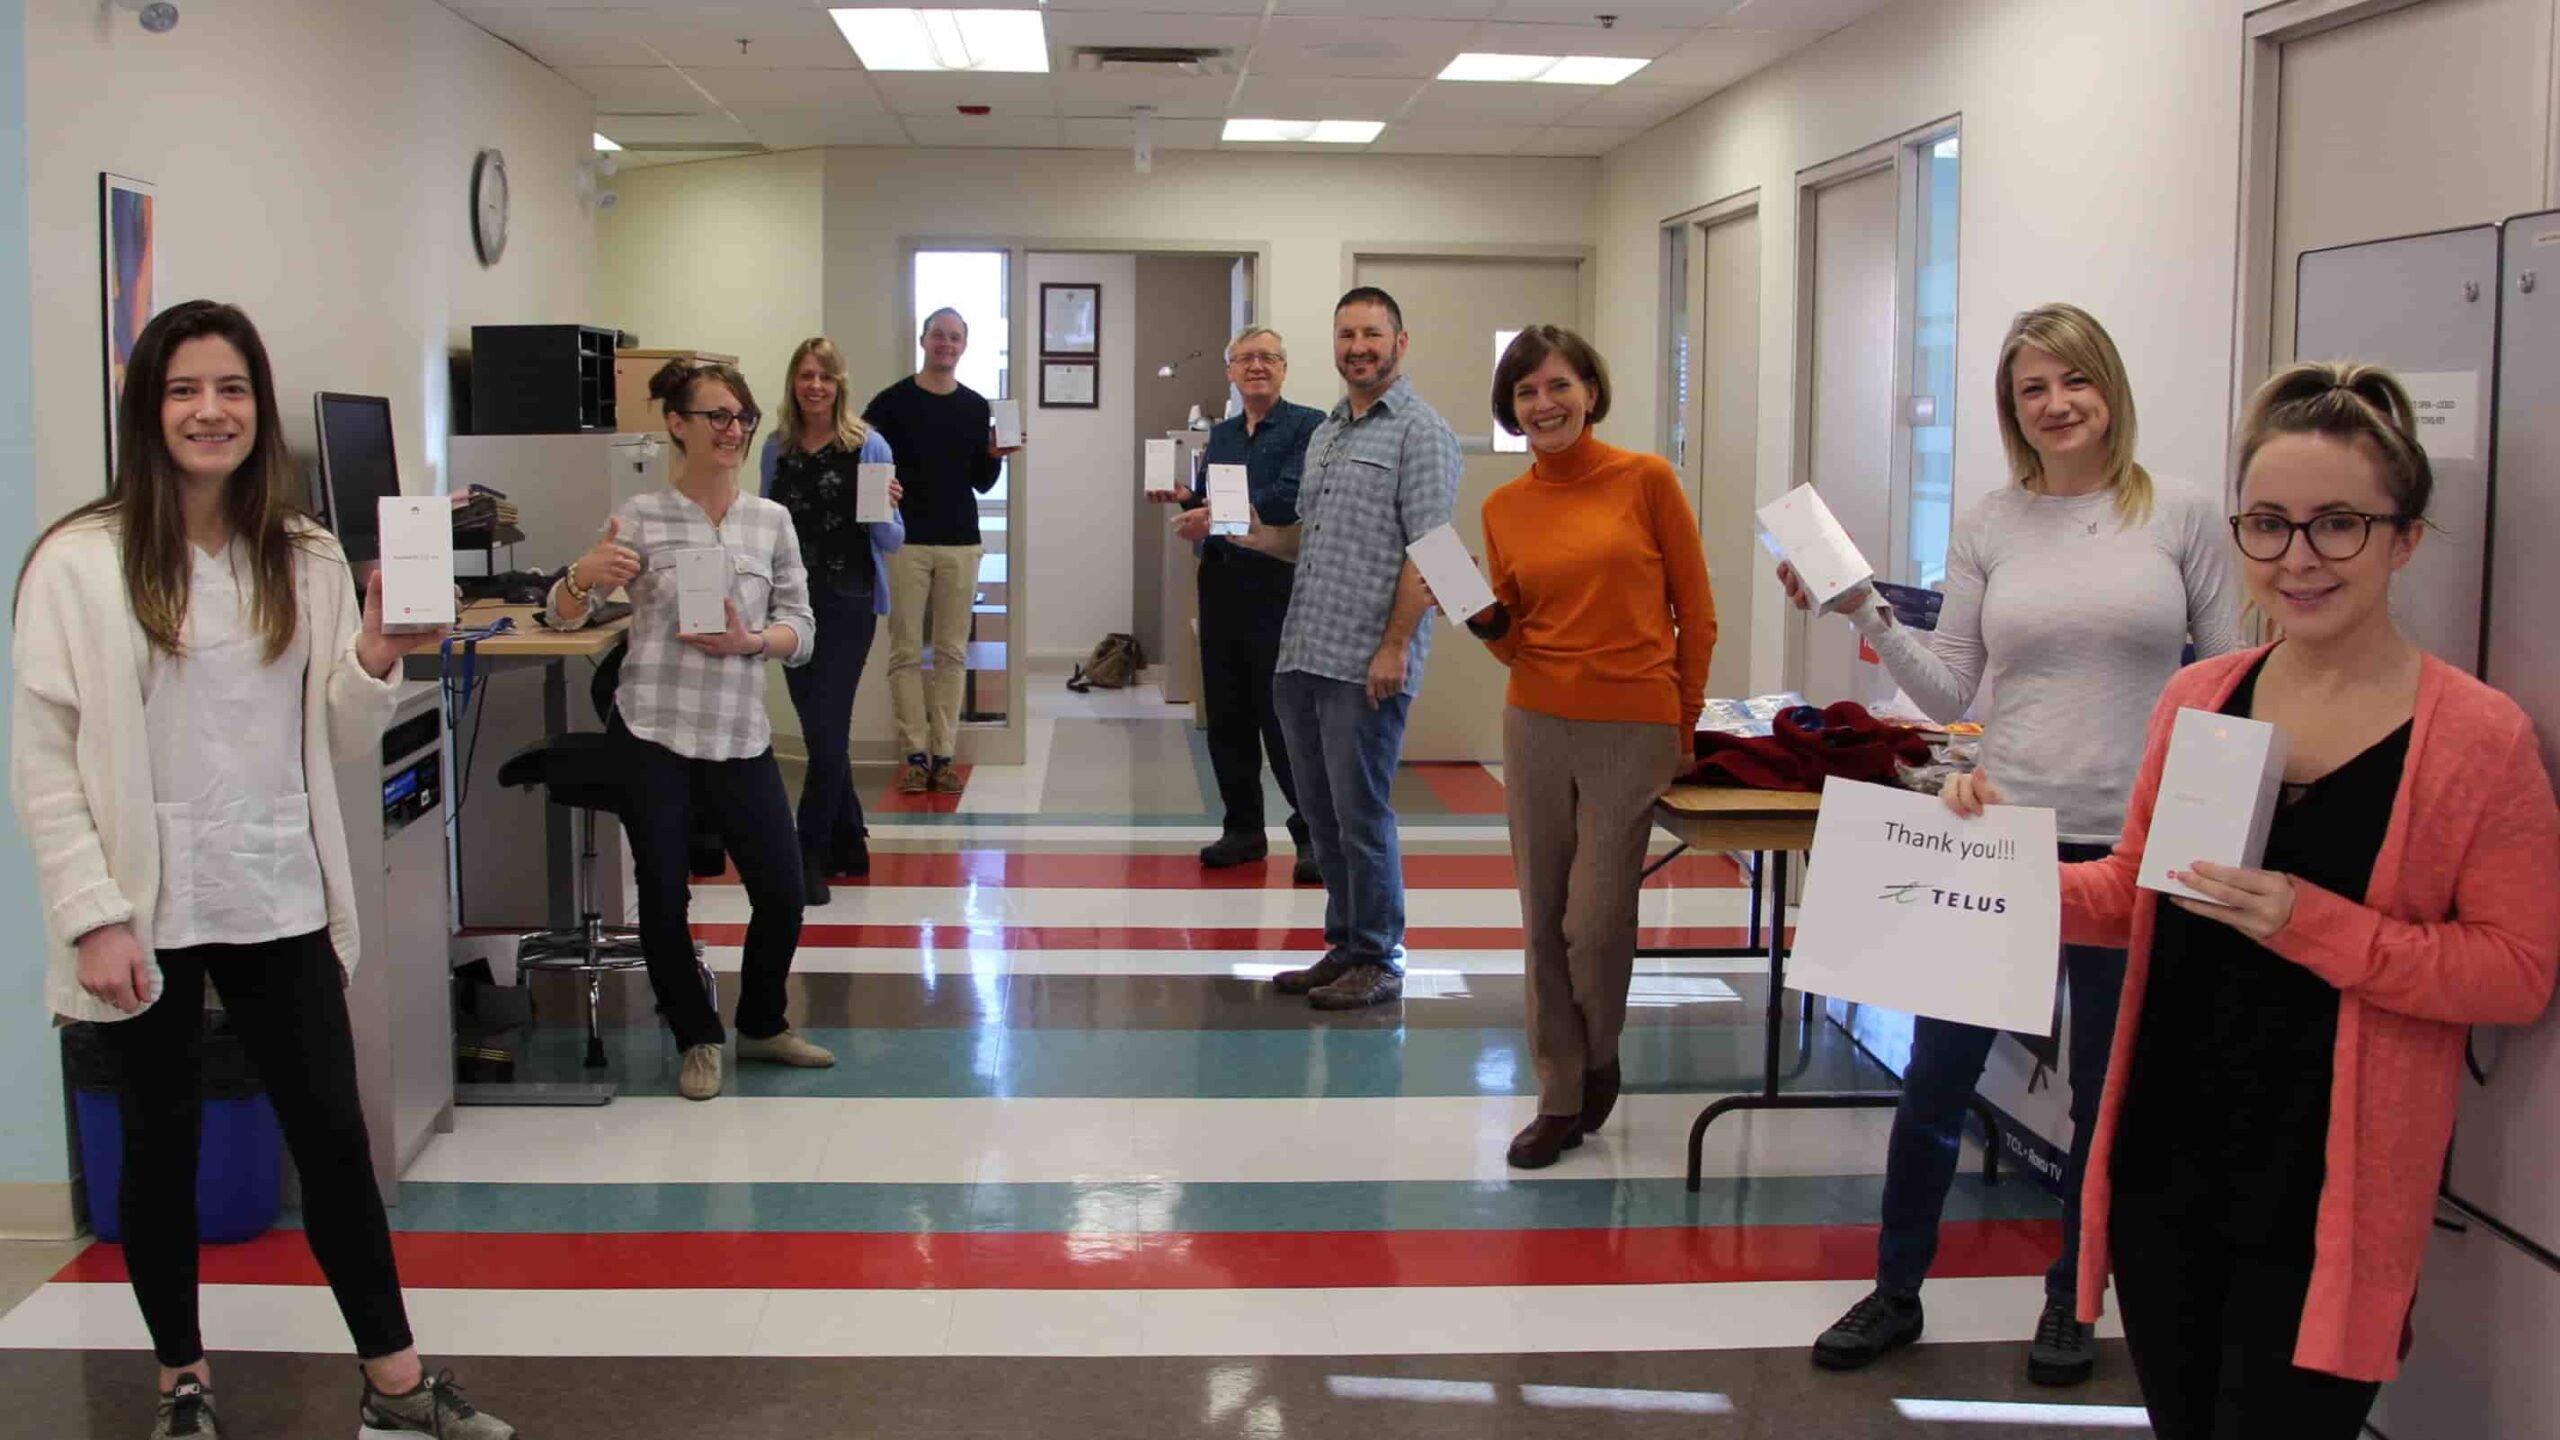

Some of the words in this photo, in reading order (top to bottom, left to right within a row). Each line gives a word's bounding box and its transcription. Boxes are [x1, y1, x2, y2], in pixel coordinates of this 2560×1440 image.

[1884, 821, 1953, 853] Thank
[1960, 839, 2016, 861] you!!!
[1932, 889, 2006, 914] TELUS
[2006, 1132, 2024, 1156] TCL
[2050, 1163, 2062, 1182] TV
